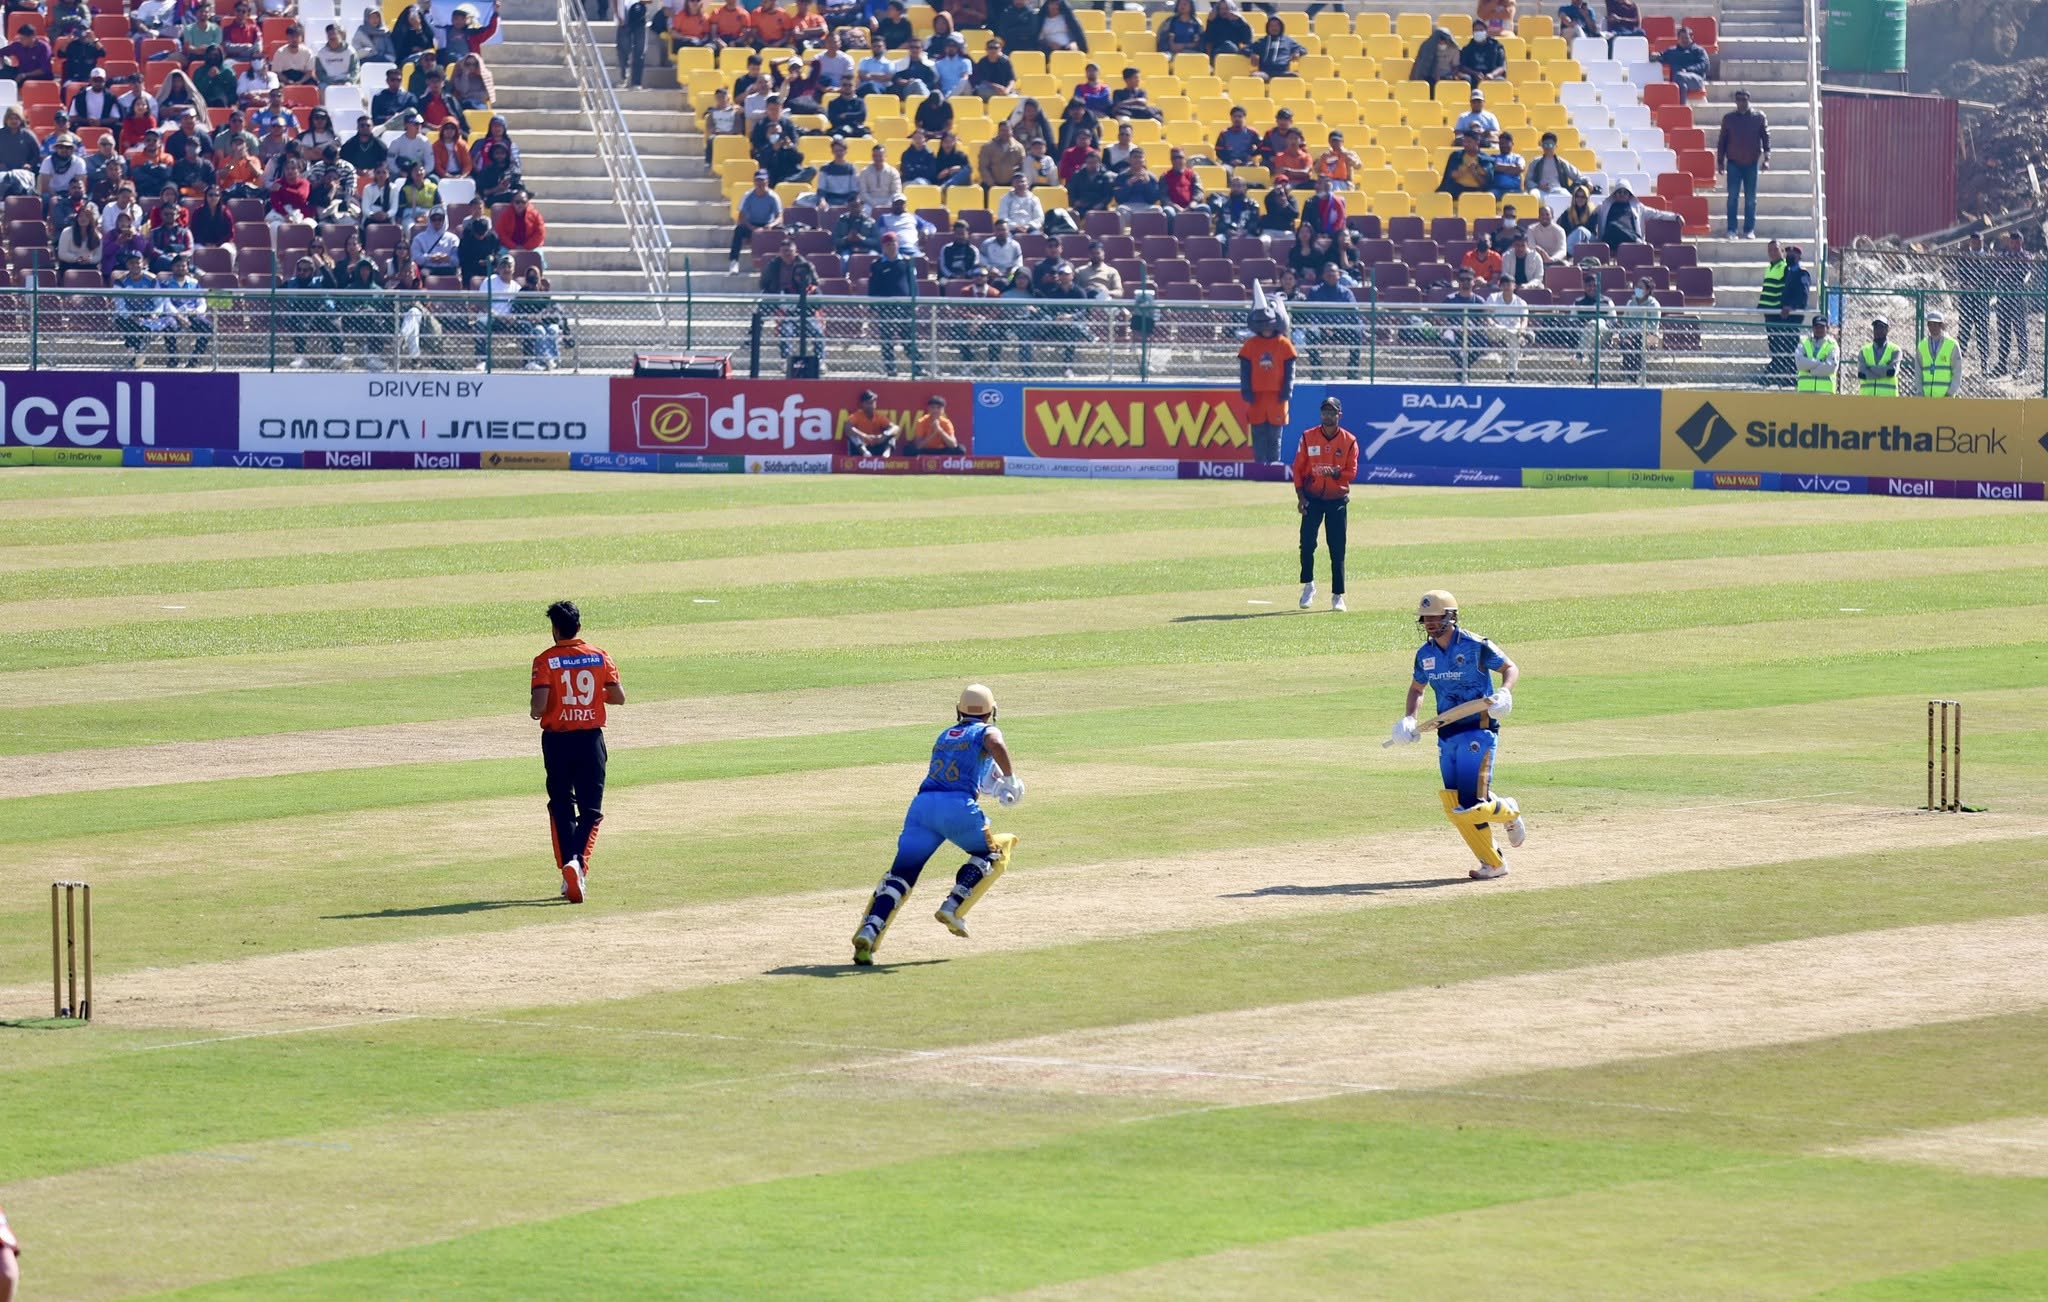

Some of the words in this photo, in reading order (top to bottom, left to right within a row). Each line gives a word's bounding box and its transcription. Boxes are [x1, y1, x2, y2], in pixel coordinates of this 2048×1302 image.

[369, 381, 449, 398] DRIVEN
[457, 382, 483, 398] BY
[982, 392, 1000, 404] CG
[1402, 394, 1481, 409] BAJAJ
[0, 381, 155, 446] cell
[259, 419, 410, 439] OMODA
[437, 420, 587, 440] JAECOO
[1035, 400, 1145, 448] WAI
[1154, 400, 1253, 448] WA
[1366, 397, 1608, 460] pulsar
[146, 452, 167, 463] WAI
[169, 452, 191, 463] WAI
[233, 452, 284, 467] vivo
[326, 451, 371, 467] Ncell
[414, 453, 460, 468] Ncell
[1199, 461, 1244, 478] Ncell
[1715, 475, 1737, 486] WAI
[1738, 475, 1760, 487] WAI
[1798, 474, 1850, 492] vivo
[1889, 478, 1934, 496] Ncell
[1977, 482, 2022, 499] Ncell
[582, 656, 600, 664] STAR
[561, 669, 595, 706] 19
[930, 759, 960, 782] 26
